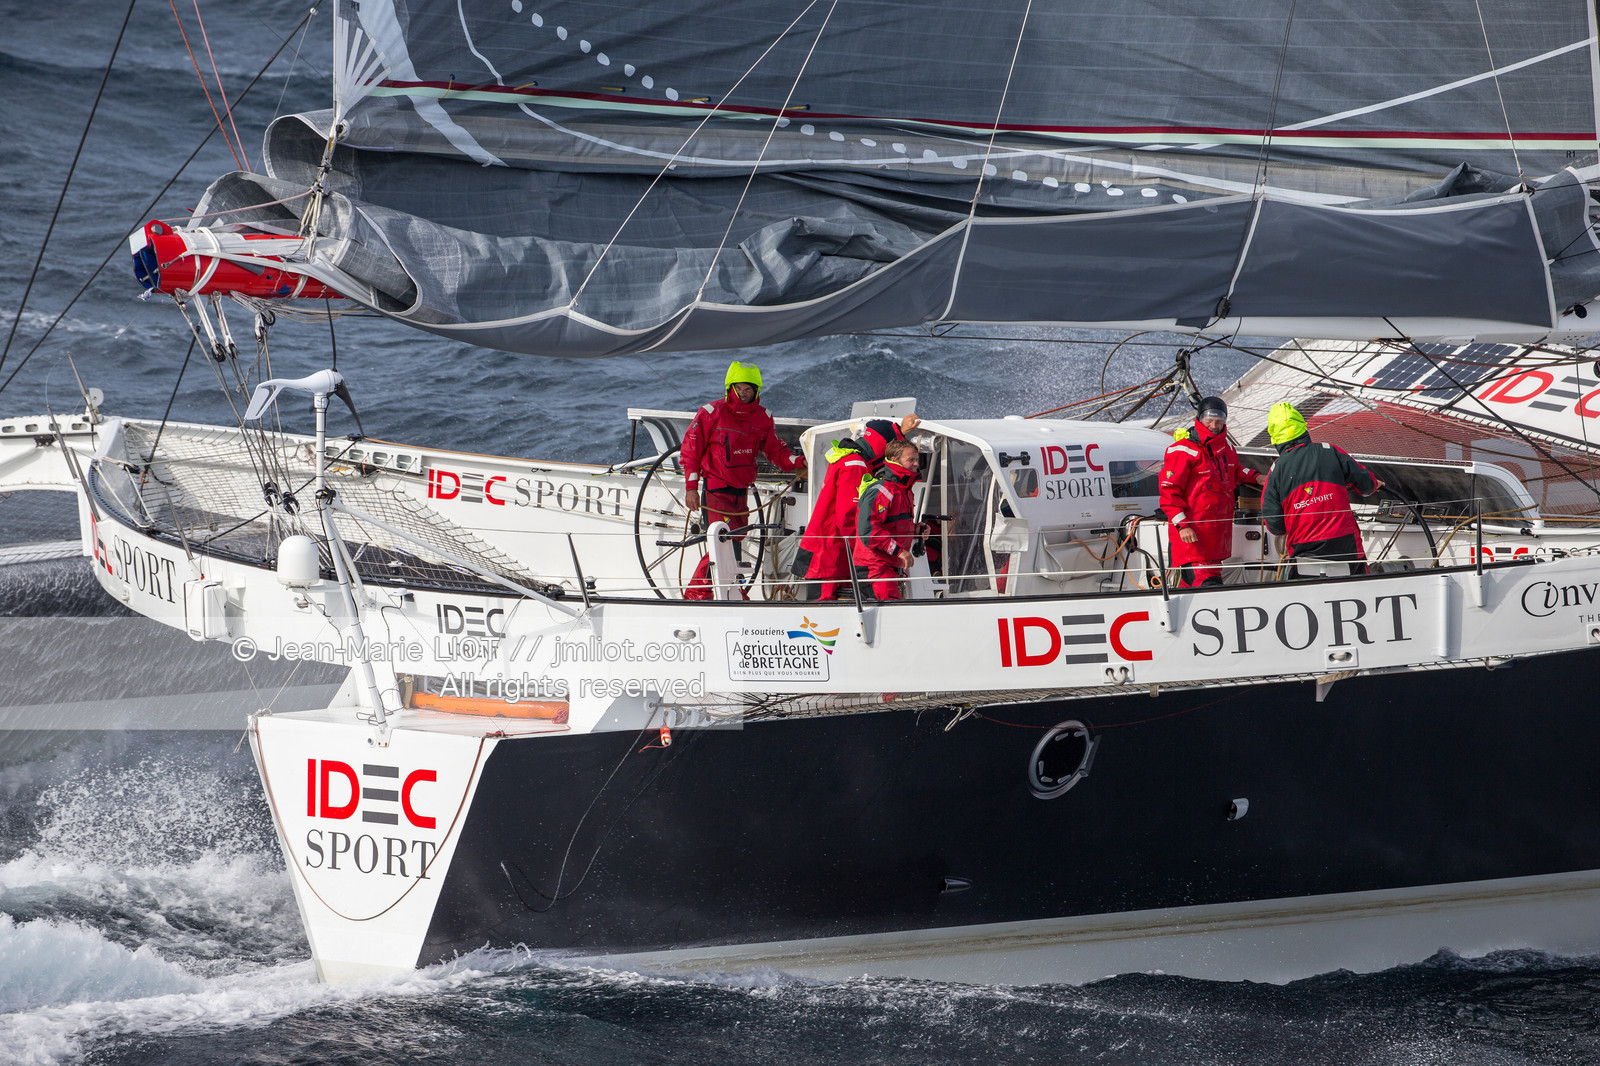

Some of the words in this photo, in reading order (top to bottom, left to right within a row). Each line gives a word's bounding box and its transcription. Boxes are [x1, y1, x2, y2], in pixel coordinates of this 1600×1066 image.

[1040, 443, 1104, 475] IDEC
[427, 469, 506, 506] IDEC
[514, 478, 630, 517] SPORT
[1045, 476, 1106, 500] SPORT
[113, 534, 176, 604] SPORT
[436, 603, 506, 639] IDEC
[741, 627, 750, 637] Je
[751, 627, 785, 636] soutiens
[997, 610, 1153, 668] IDEC
[1191, 593, 1418, 657] SPORT
[732, 640, 819, 660] Agriculteurs
[739, 658, 750, 669] de
[752, 656, 820, 669] BRETAGNE
[307, 758, 437, 830] IDEC
[305, 828, 437, 880] SPORT
